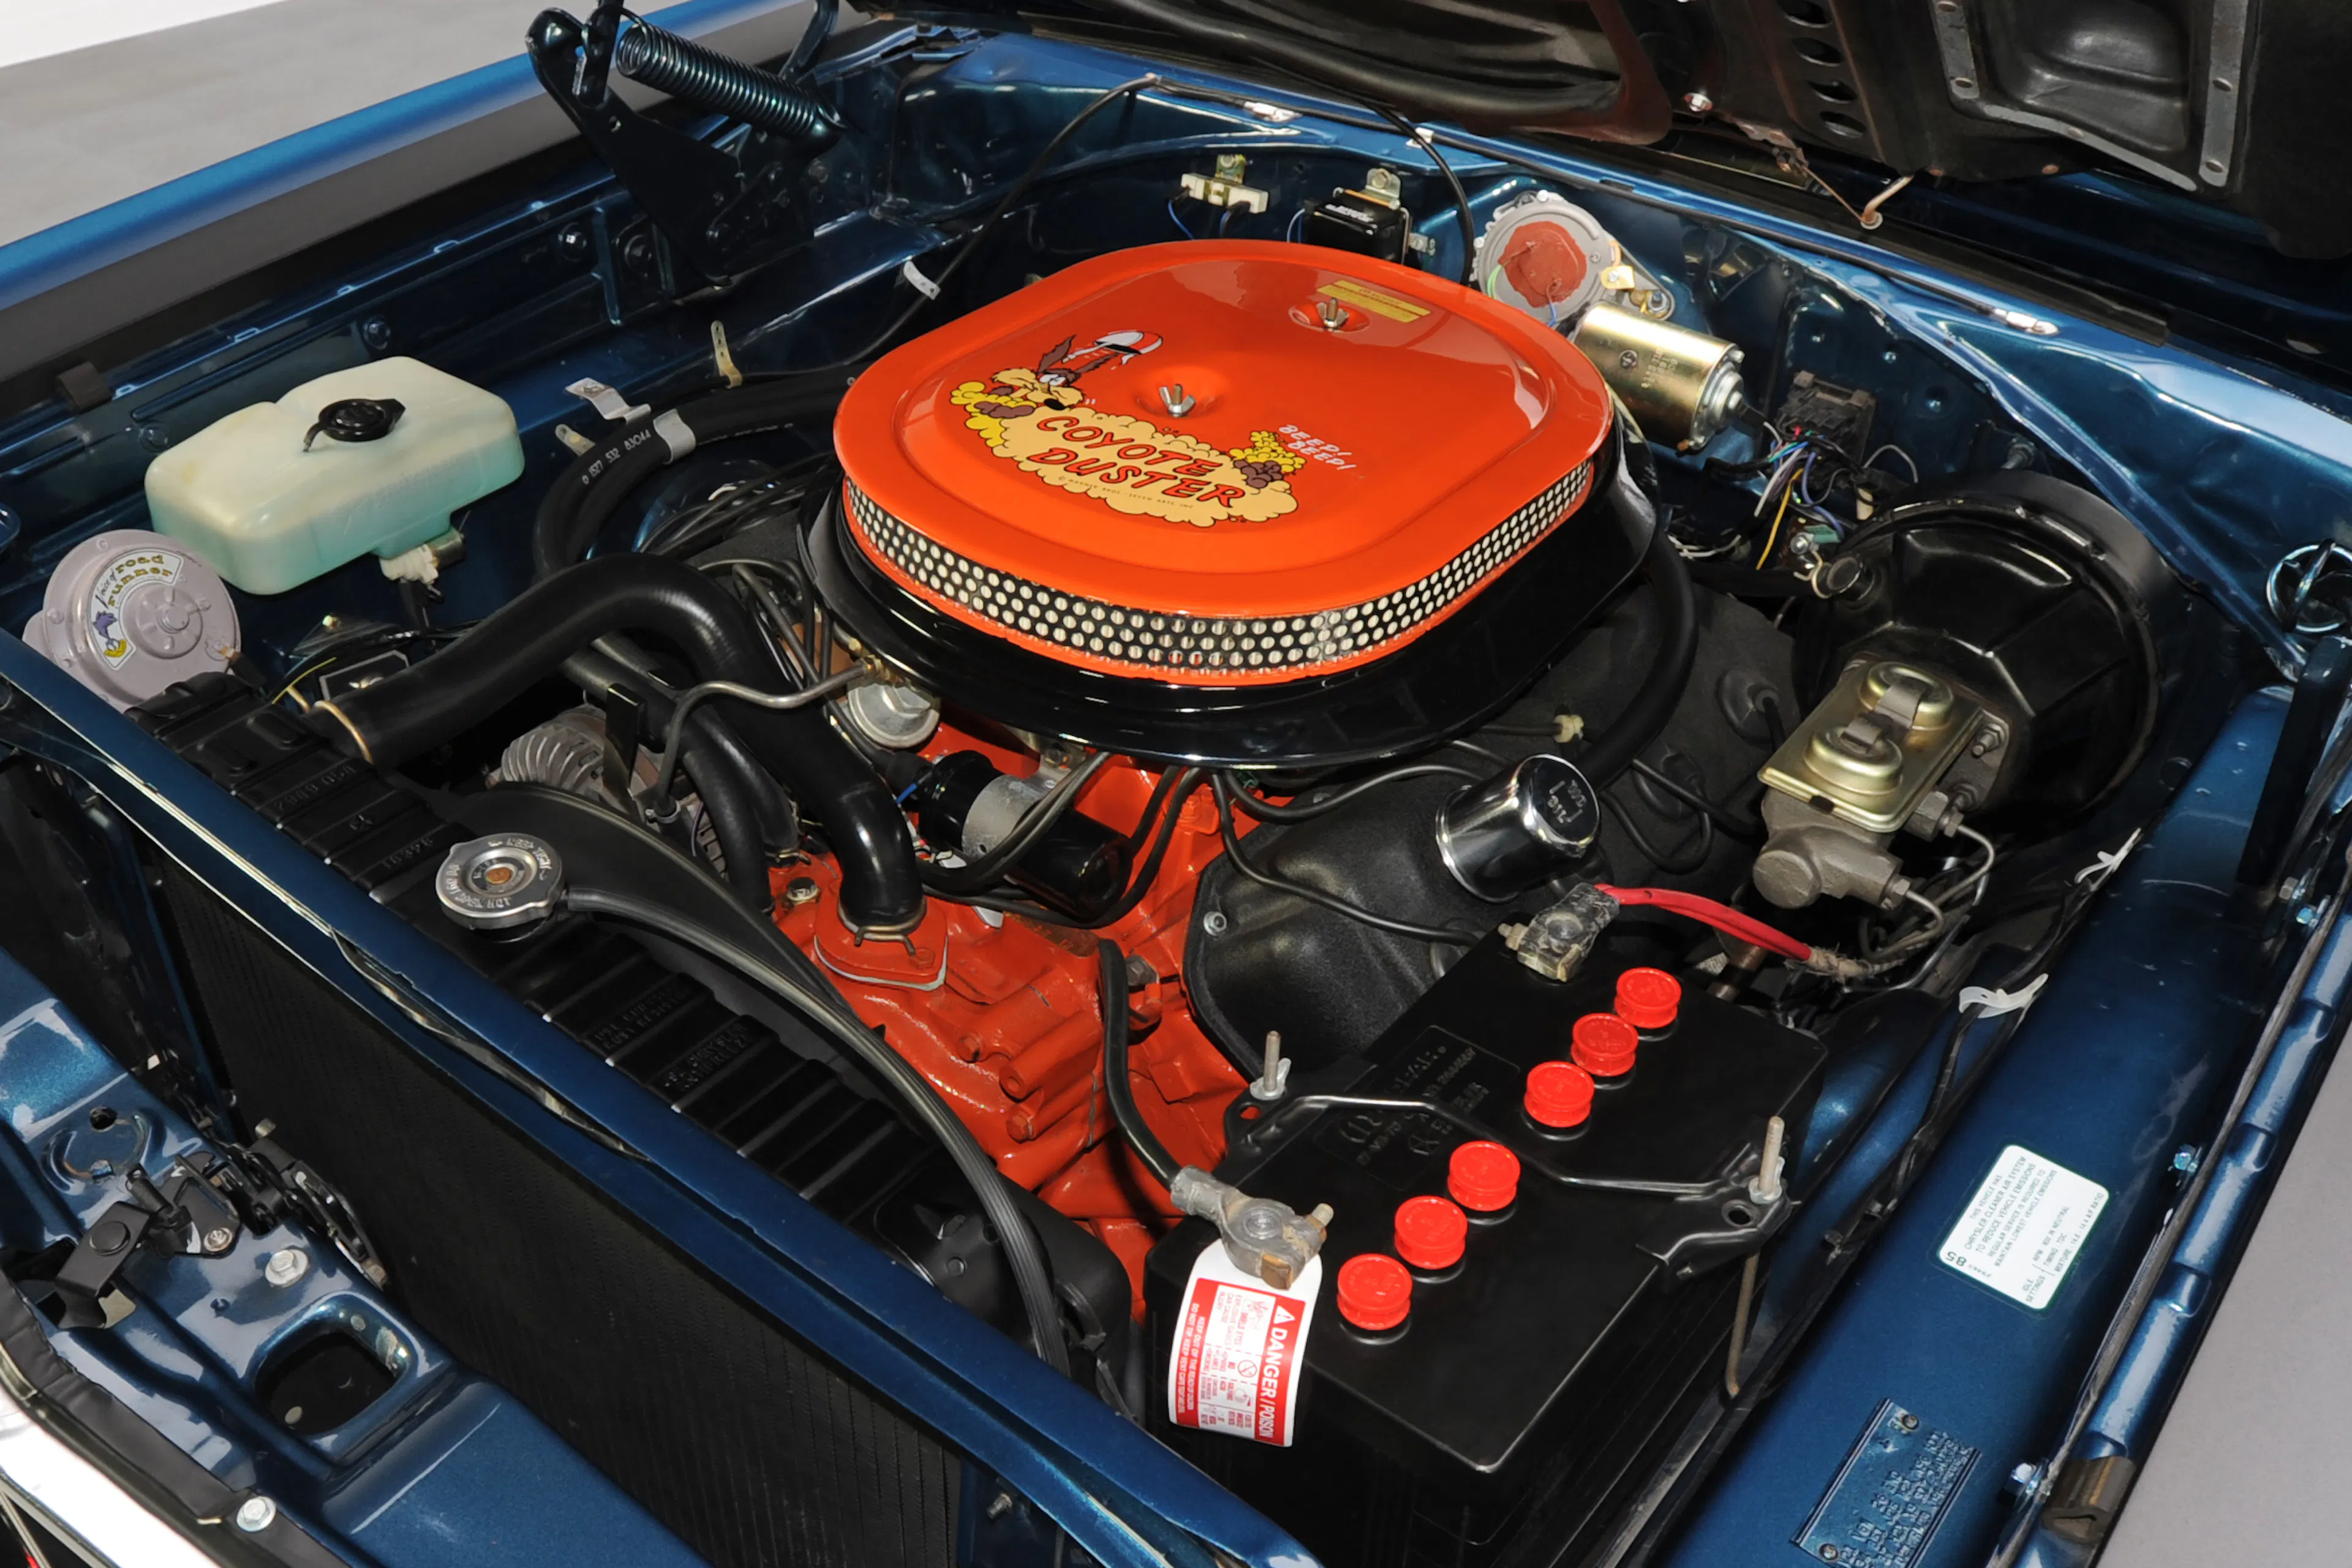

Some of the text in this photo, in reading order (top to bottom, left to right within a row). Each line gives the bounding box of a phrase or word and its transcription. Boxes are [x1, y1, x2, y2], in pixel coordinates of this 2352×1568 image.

[605, 448, 621, 464] 532
[1036, 415, 1223, 477] COYOTE
[1278, 424, 1352, 456] BEEP!
[1287, 440, 1357, 470] BEEP!
[1027, 447, 1245, 509] DUSTER
[1068, 478, 1098, 488] WARNER
[115, 554, 164, 574] road
[107, 567, 173, 606] runner
[1964, 1218, 1988, 1250] CHRYSLER
[1984, 1191, 2005, 1218] CLEANER
[2002, 1180, 2011, 1189] AIR
[2008, 1156, 2026, 1179] SYSTEM
[1970, 1174, 2002, 1219] THIS VEHICLE HAS
[1976, 1243, 1985, 1253] TO
[1982, 1219, 2000, 1243] REDUCE
[1997, 1194, 2016, 1218] VEHICLE
[2013, 1163, 2035, 1193] EMISSIONS
[2090, 1193, 2104, 1209] RATIO
[1988, 1232, 2007, 1257] REGULAR
[2003, 1210, 2020, 1231] SERVICE
[2021, 1177, 2040, 1203] REQUIRED
[1994, 1169, 2056, 1266] MAINTAIN LOWEST VEHICLE EMISSIONS
[2052, 1205, 2069, 1229] NEUTRAL
[1945, 1251, 1967, 1267] 85
[2026, 1275, 2045, 1302] SETTINGS
[1261, 1329, 1288, 1400] DANGER
[1259, 1404, 1276, 1439] POISON
